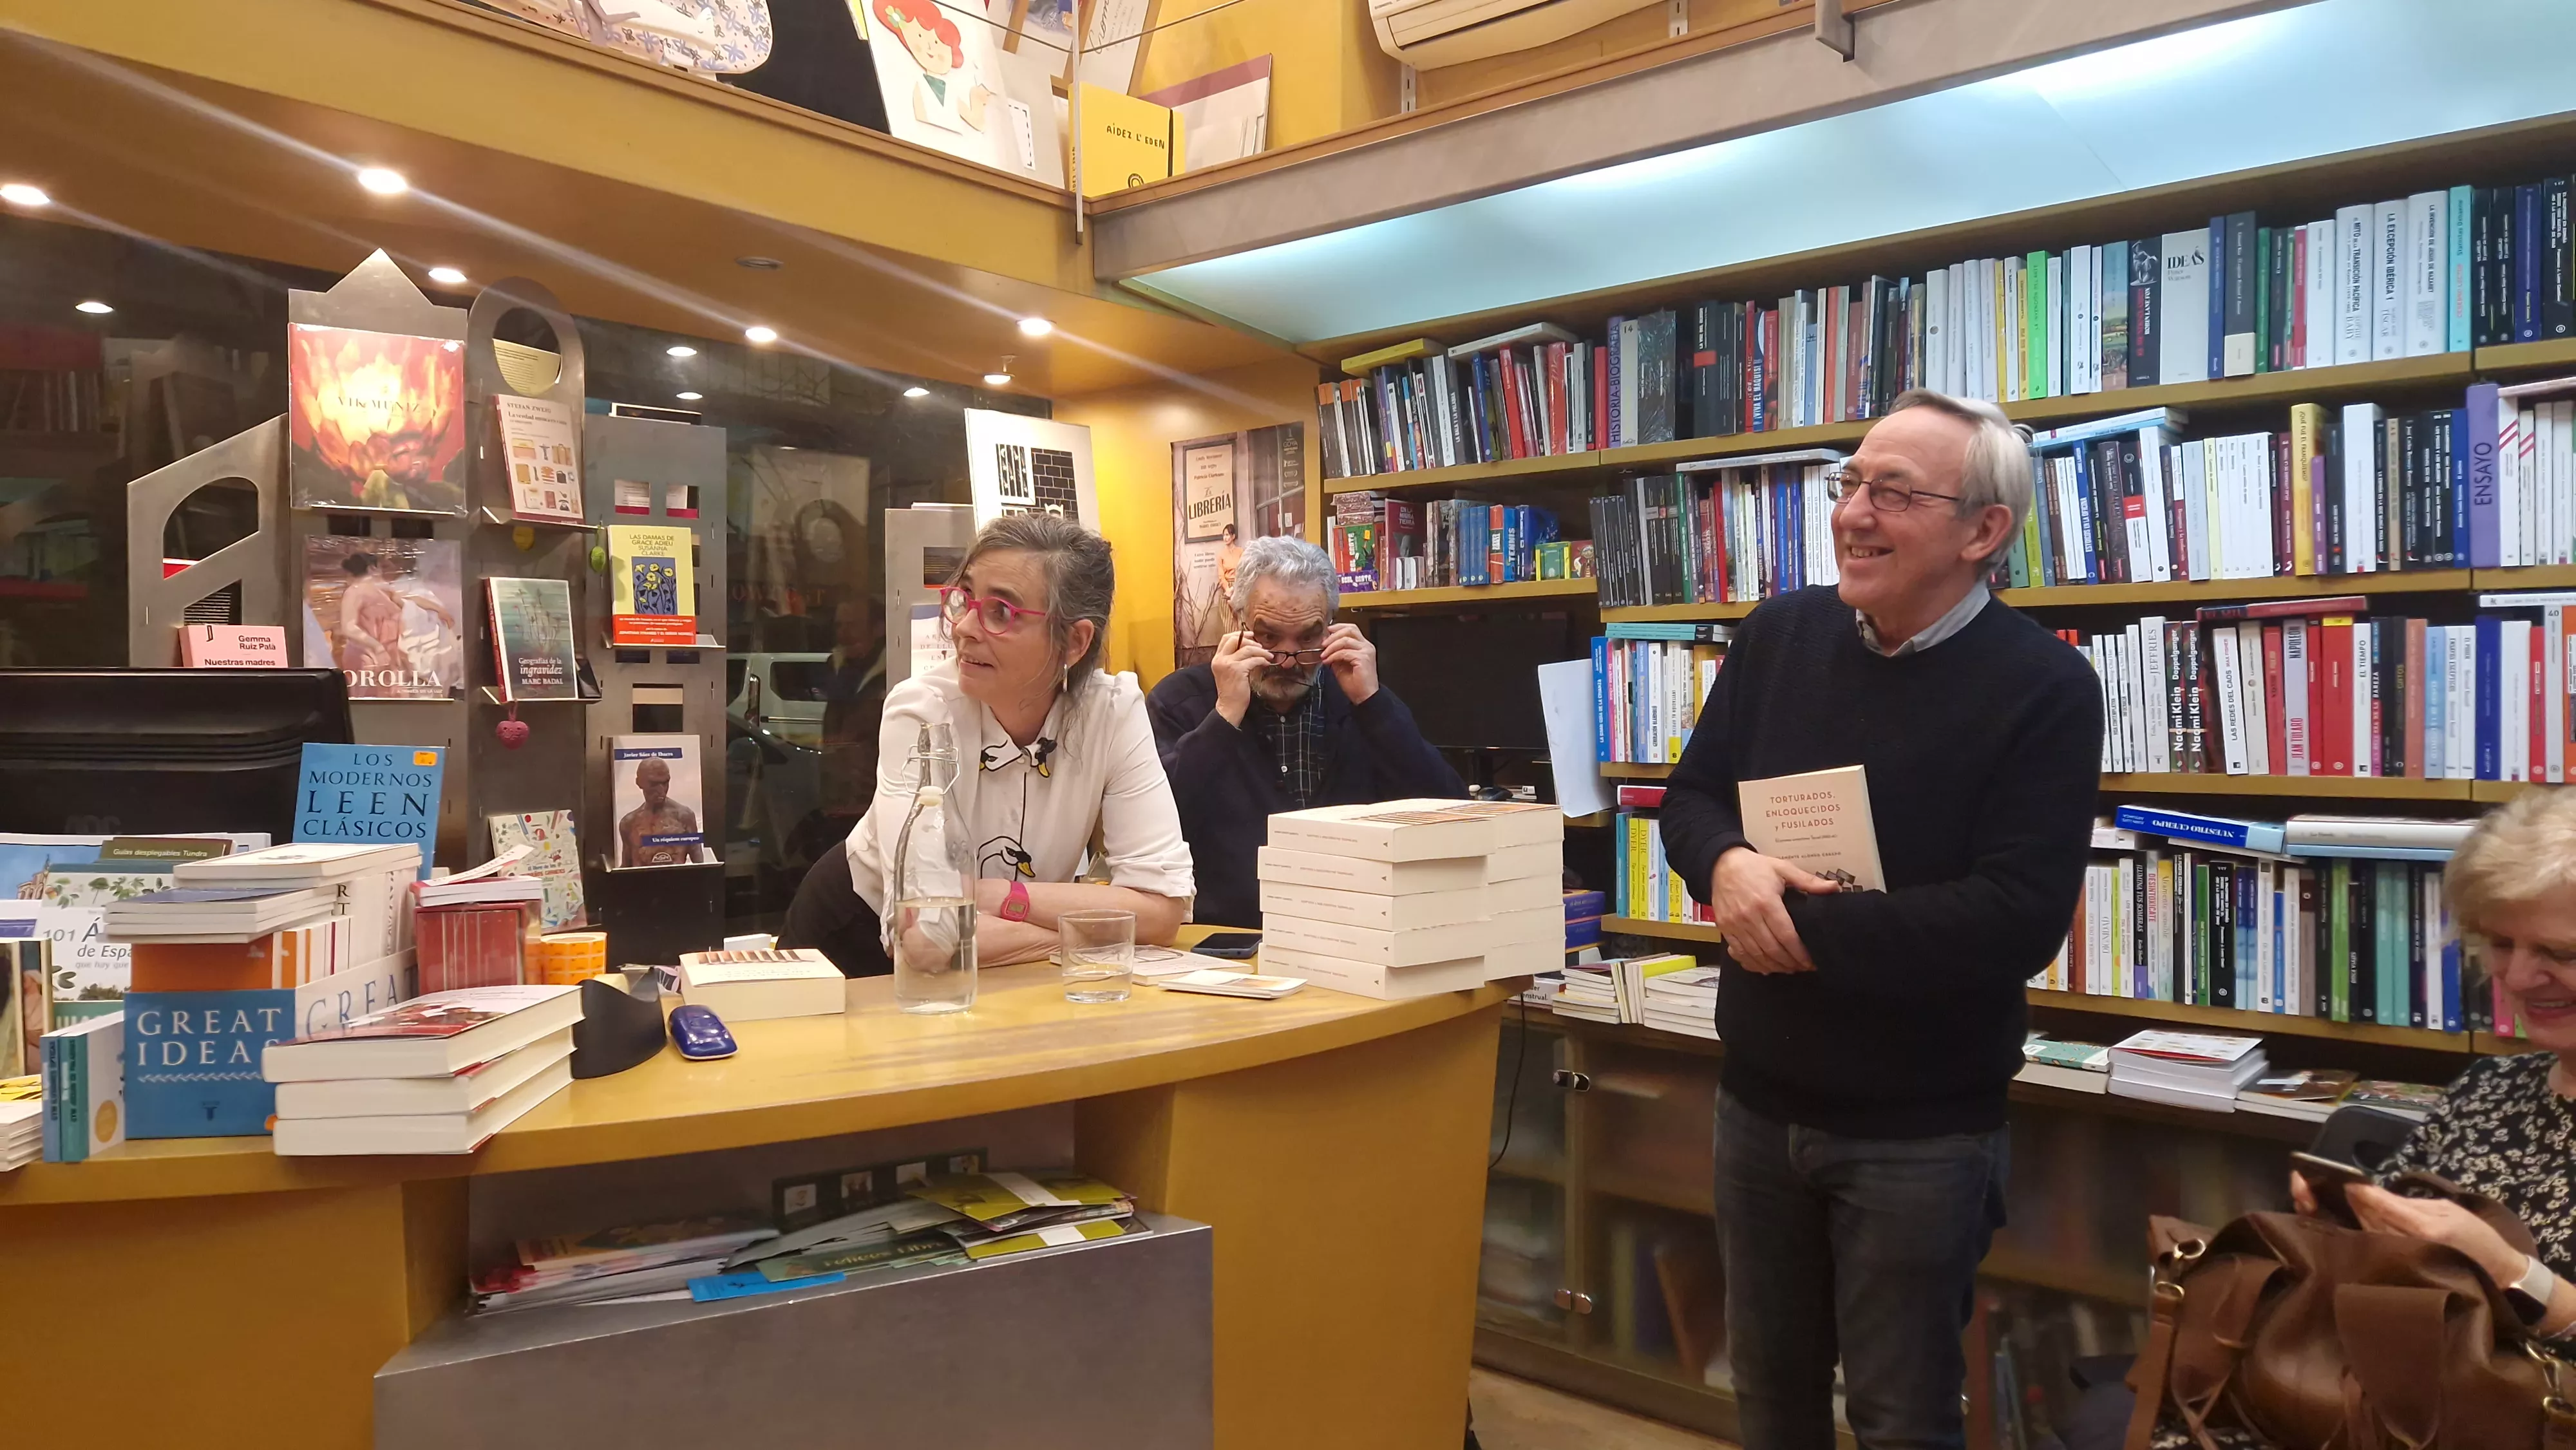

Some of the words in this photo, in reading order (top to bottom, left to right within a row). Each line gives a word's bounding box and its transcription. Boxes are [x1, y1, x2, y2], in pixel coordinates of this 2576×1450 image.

[2387, 213, 2396, 222] LA
[2386, 223, 2397, 265] EXCEPCIÓN
[2166, 246, 2205, 270] IDEAS
[2353, 249, 2362, 284] TRANSICIÓN
[2386, 267, 2396, 294] IBÉRICA
[2352, 285, 2362, 312] PACÍFICA
[1624, 325, 1634, 334] 14
[2345, 317, 2354, 340] BABY
[1754, 364, 1762, 391] MAQUIS!
[1753, 402, 1762, 419] ¡VIVA
[2474, 442, 2492, 506] ENSAYO
[1188, 491, 1231, 520] LIBRERÍA
[2080, 497, 2089, 516] OFICINA
[2148, 629, 2161, 675] JEFFRIES
[2171, 630, 2181, 680] Doppelganger
[2189, 630, 2198, 680] Doppelganger
[2286, 626, 2302, 659] NAPOLEÓN
[520, 665, 563, 677] ingravidez
[2171, 686, 2182, 713] Klein
[2189, 686, 2200, 713] Klein
[2172, 715, 2185, 751] Naomi
[2190, 715, 2202, 752] Naomi
[354, 753, 393, 766] LOS
[2291, 744, 2304, 760] JEAN
[309, 771, 432, 787] MODERNOS
[307, 790, 429, 817] LEEN
[1766, 804, 1841, 818] ENLOQUECIDOS
[303, 817, 426, 838] CLÁSICOS
[1781, 818, 1834, 829] FUSILADOS
[2152, 820, 2189, 831] CUERPO
[2191, 825, 2234, 838] NUESTRO
[135, 849, 181, 858] desplegables
[183, 849, 207, 858] Tundra
[43, 929, 75, 941] 101
[2101, 916, 2110, 954] DIGNIDAD
[77, 944, 95, 957] de
[137, 1008, 283, 1037] GREAT
